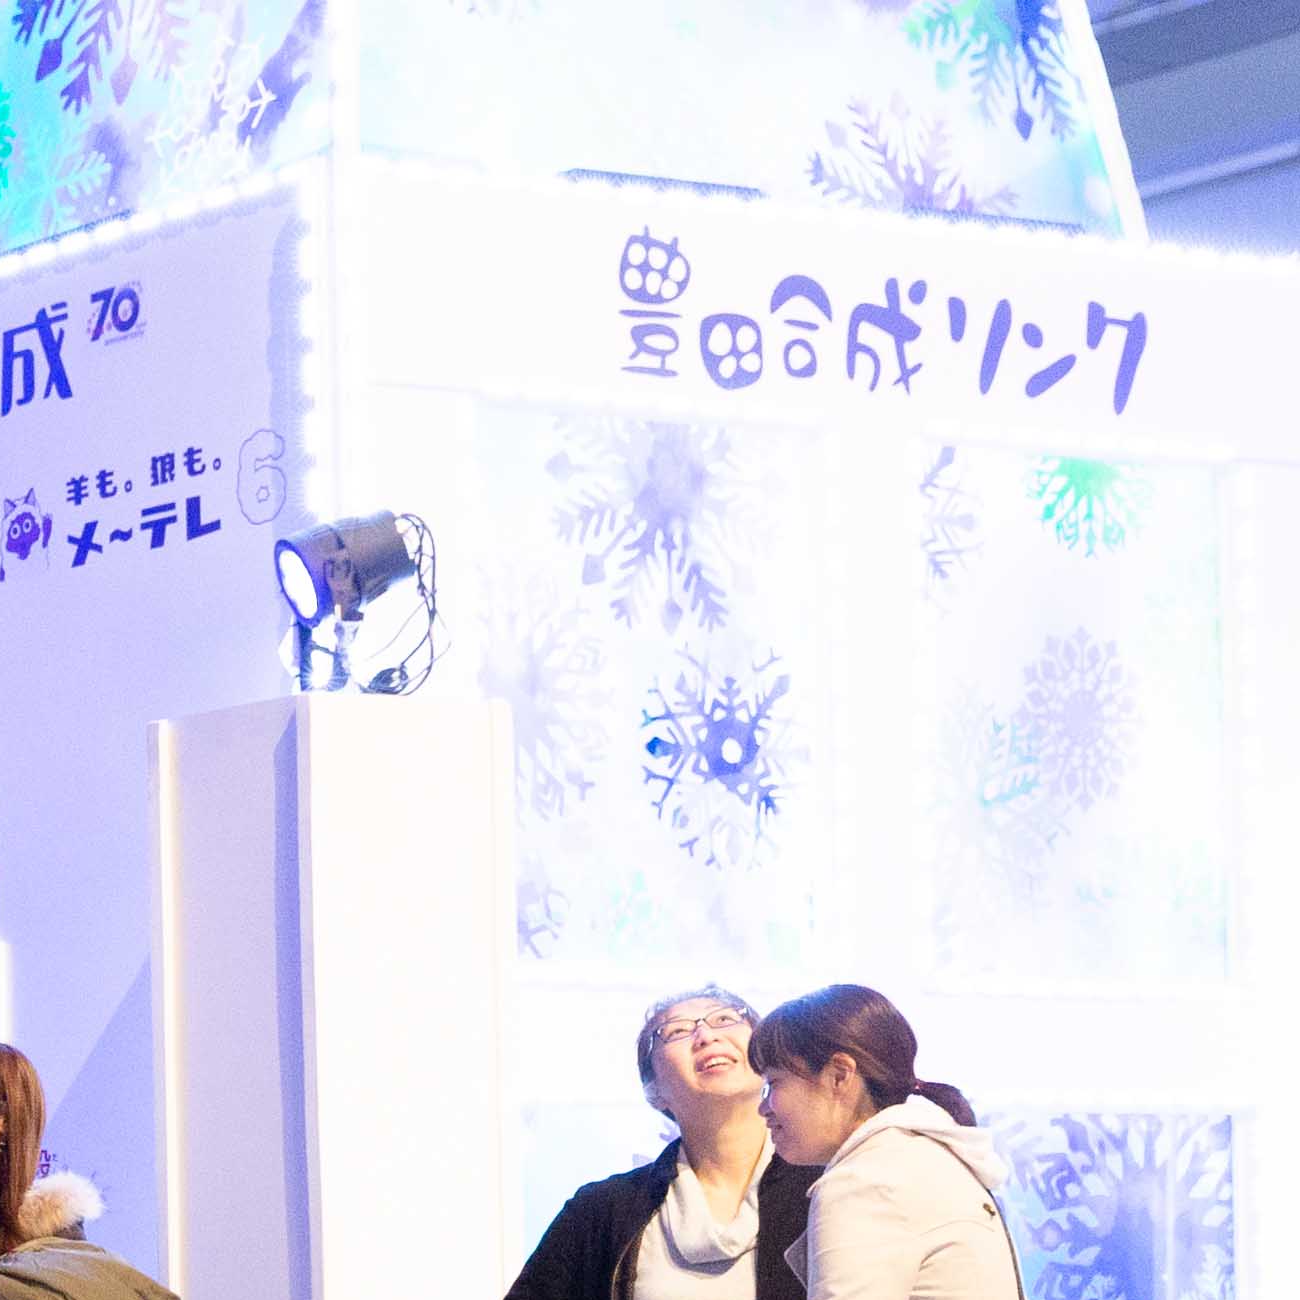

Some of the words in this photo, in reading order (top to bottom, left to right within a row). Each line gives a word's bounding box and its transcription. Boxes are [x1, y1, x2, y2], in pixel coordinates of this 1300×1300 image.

[90, 286, 139, 341] 70
[619, 226, 1147, 416] 豊田合成リンク
